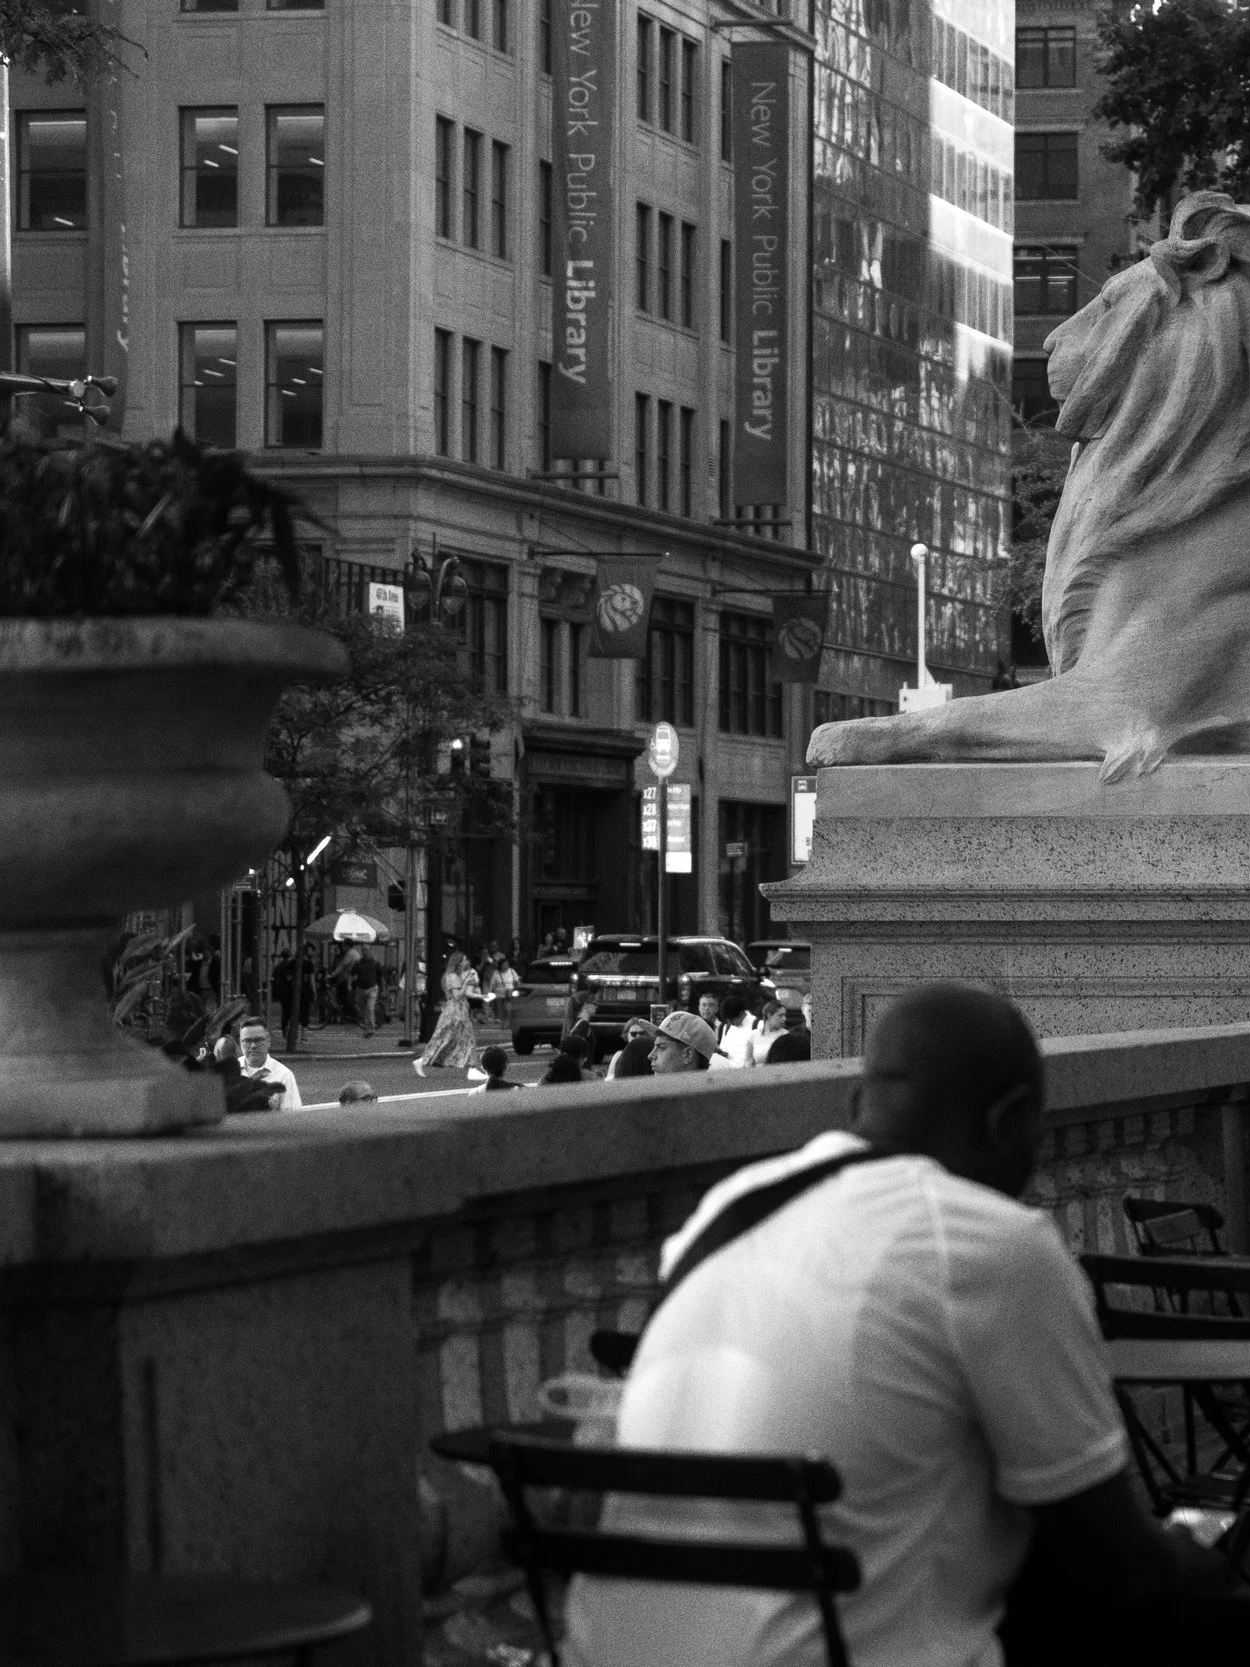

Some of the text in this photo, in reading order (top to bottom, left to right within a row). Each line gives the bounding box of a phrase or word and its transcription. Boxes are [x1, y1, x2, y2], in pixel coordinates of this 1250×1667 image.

[567, 69, 598, 138] York
[566, 153, 598, 244] Public
[745, 81, 780, 442] New York Public Library
[558, 259, 597, 385] Library
